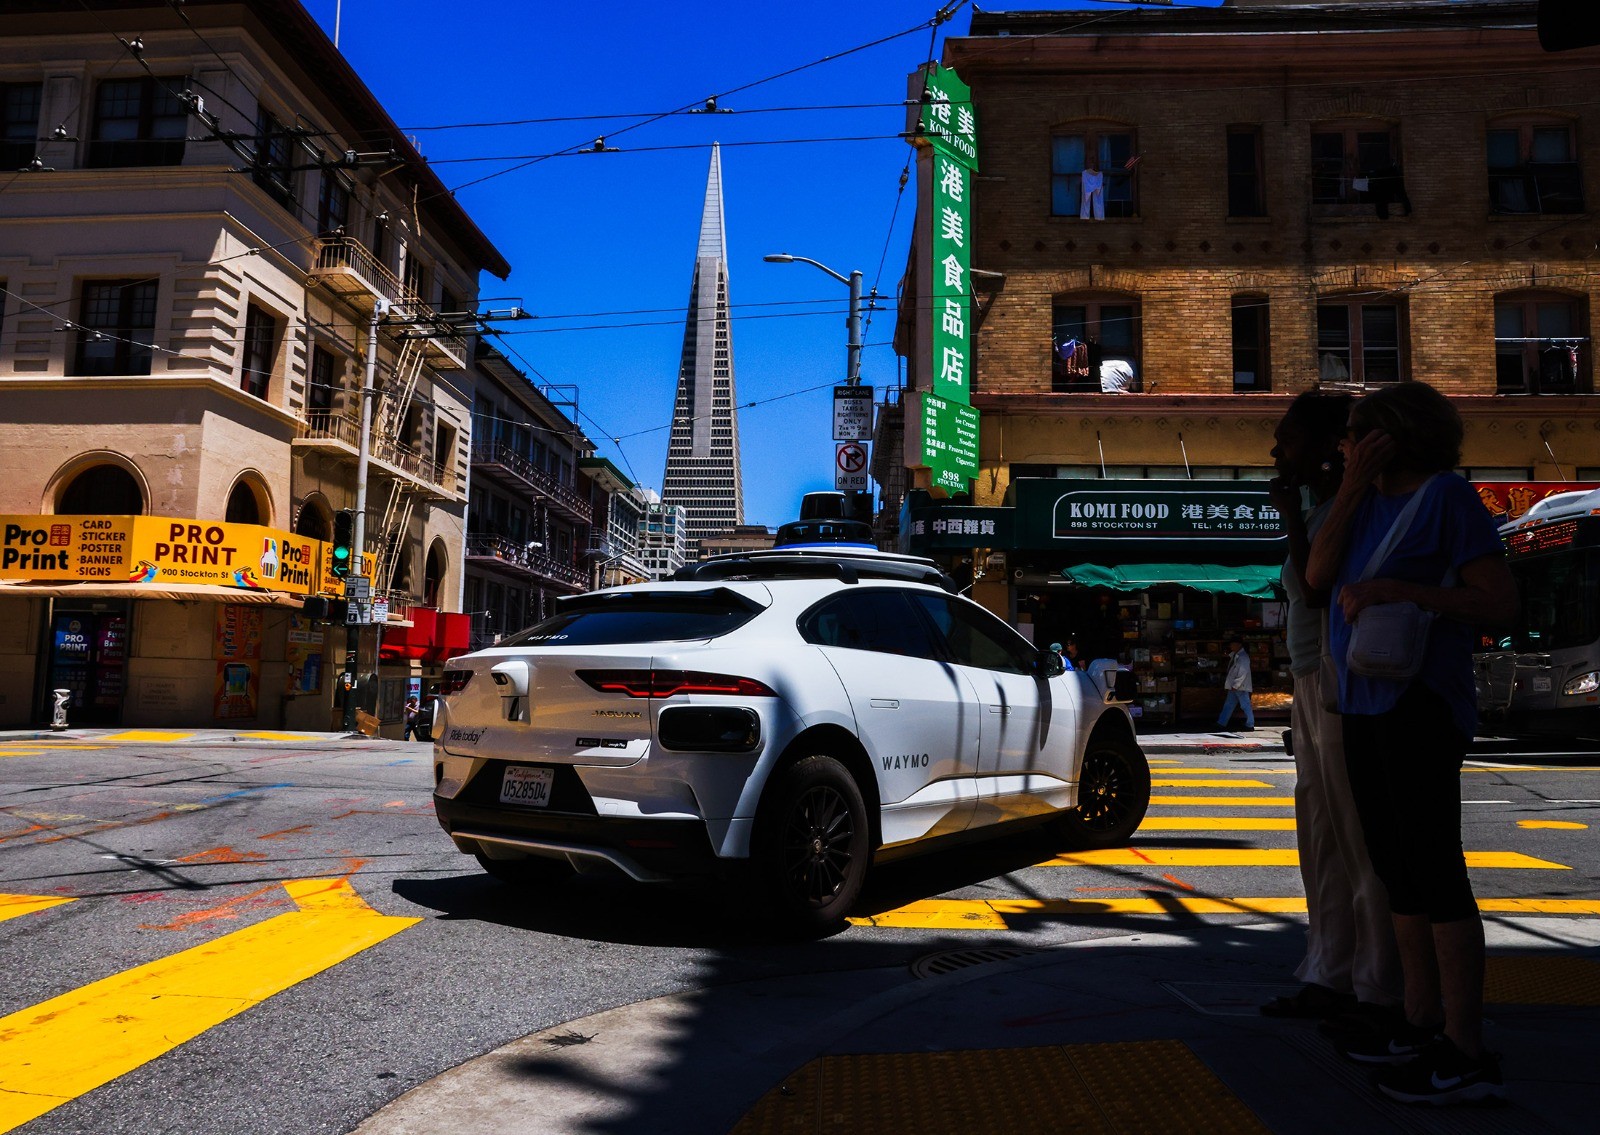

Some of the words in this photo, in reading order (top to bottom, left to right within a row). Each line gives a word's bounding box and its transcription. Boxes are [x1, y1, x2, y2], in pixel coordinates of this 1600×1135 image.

[930, 85, 975, 142] 港美
[929, 118, 952, 144] KOMI
[954, 135, 975, 158] FOOD
[941, 158, 964, 386] 港美食品店
[959, 408, 976, 420] Grocery
[962, 419, 976, 429] Cream
[957, 427, 976, 439] Beverage
[948, 444, 963, 455] Frozen
[959, 438, 976, 448] Noodles
[837, 476, 848, 485] ON
[850, 476, 865, 485] RED
[942, 470, 959, 482] 898
[937, 477, 964, 490] STOCKTON
[1070, 503, 1117, 519] KOMI
[1121, 503, 1170, 519] FOOD
[932, 518, 996, 536] 中西雜貨
[1070, 521, 1088, 529] 898
[1091, 521, 1144, 530] STOCKTON
[1216, 522, 1234, 530] 415
[1238, 522, 1281, 530] 837-1692
[4, 524, 49, 546] Pro
[169, 523, 225, 545] PRO
[155, 543, 237, 566] PRINT
[282, 540, 303, 563] Pro
[2, 548, 69, 570] Print
[162, 568, 178, 577] 900
[180, 569, 218, 579] Stockton
[221, 571, 229, 579] St
[280, 562, 309, 585] Print
[64, 634, 84, 642] PRO
[60, 643, 88, 651] PRINT
[591, 710, 642, 718] JAGUAR
[449, 729, 462, 741] Ride
[462, 730, 481, 745] today
[882, 753, 929, 770] WAYMO
[503, 780, 546, 800] 05285D4
